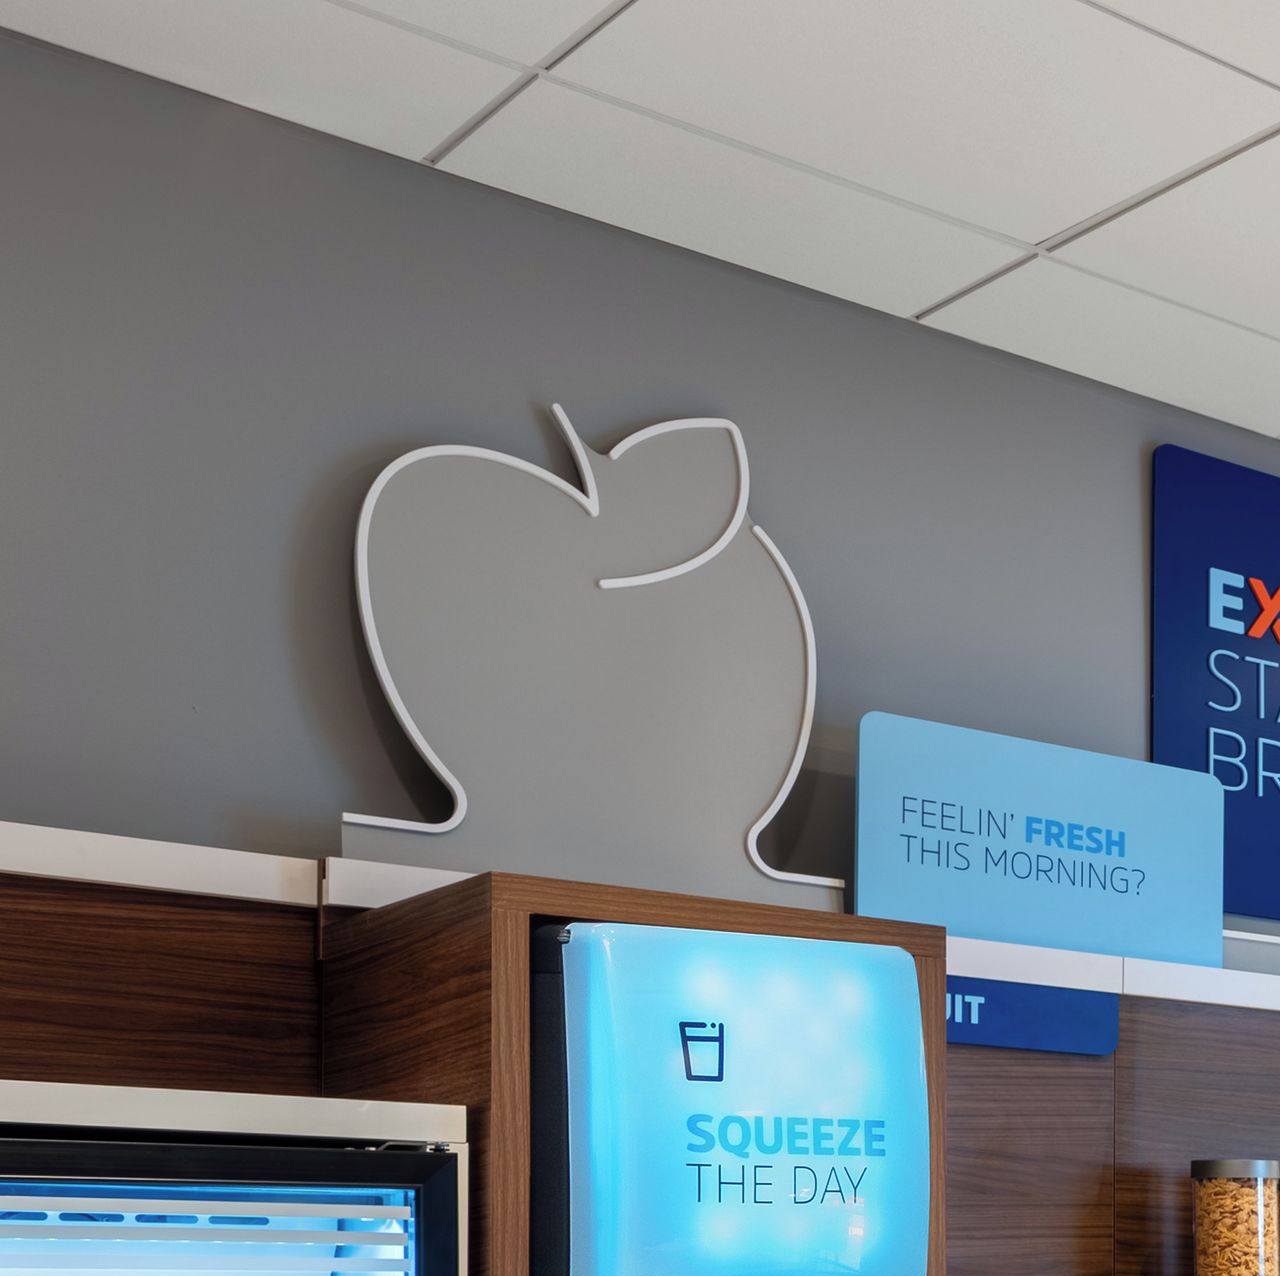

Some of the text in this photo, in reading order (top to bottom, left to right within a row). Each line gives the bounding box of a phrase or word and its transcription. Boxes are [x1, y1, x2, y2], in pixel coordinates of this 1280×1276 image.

[1025, 815, 1126, 858] FRESH
[900, 833, 1146, 896] THIS MORNING?
[946, 992, 986, 1025] IT
[686, 1113, 886, 1159] SQUEEZE
[686, 1163, 868, 1205] THE DAY
